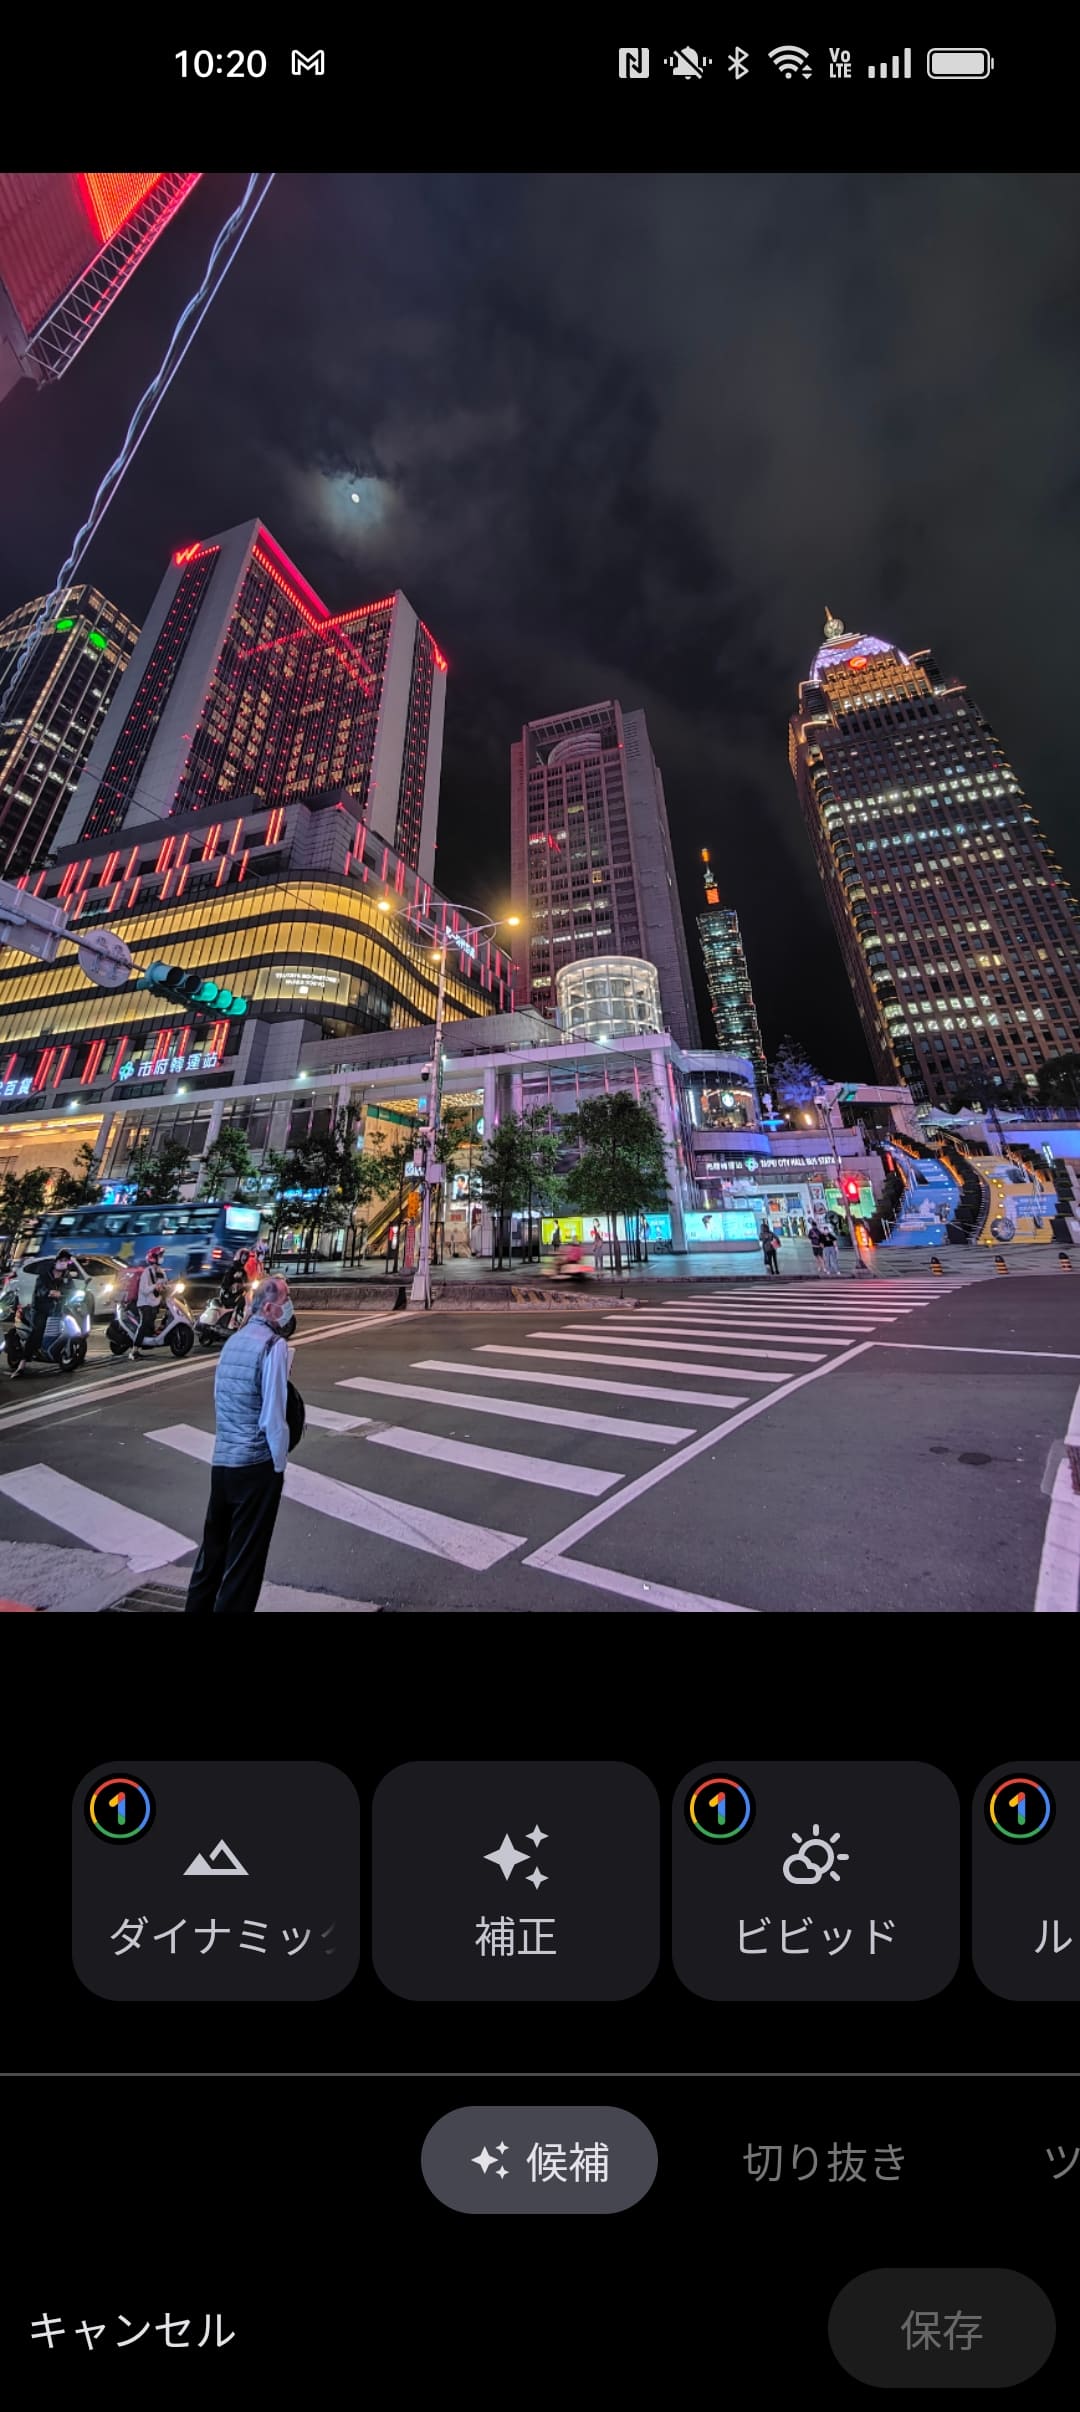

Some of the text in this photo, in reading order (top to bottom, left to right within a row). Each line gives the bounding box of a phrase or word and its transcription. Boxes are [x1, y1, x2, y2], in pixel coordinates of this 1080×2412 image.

[136, 1052, 218, 1078] 市府轉運站
[0, 1077, 34, 1097] 百貨
[778, 1158, 791, 1168] CITY
[790, 1157, 806, 1167] HALL
